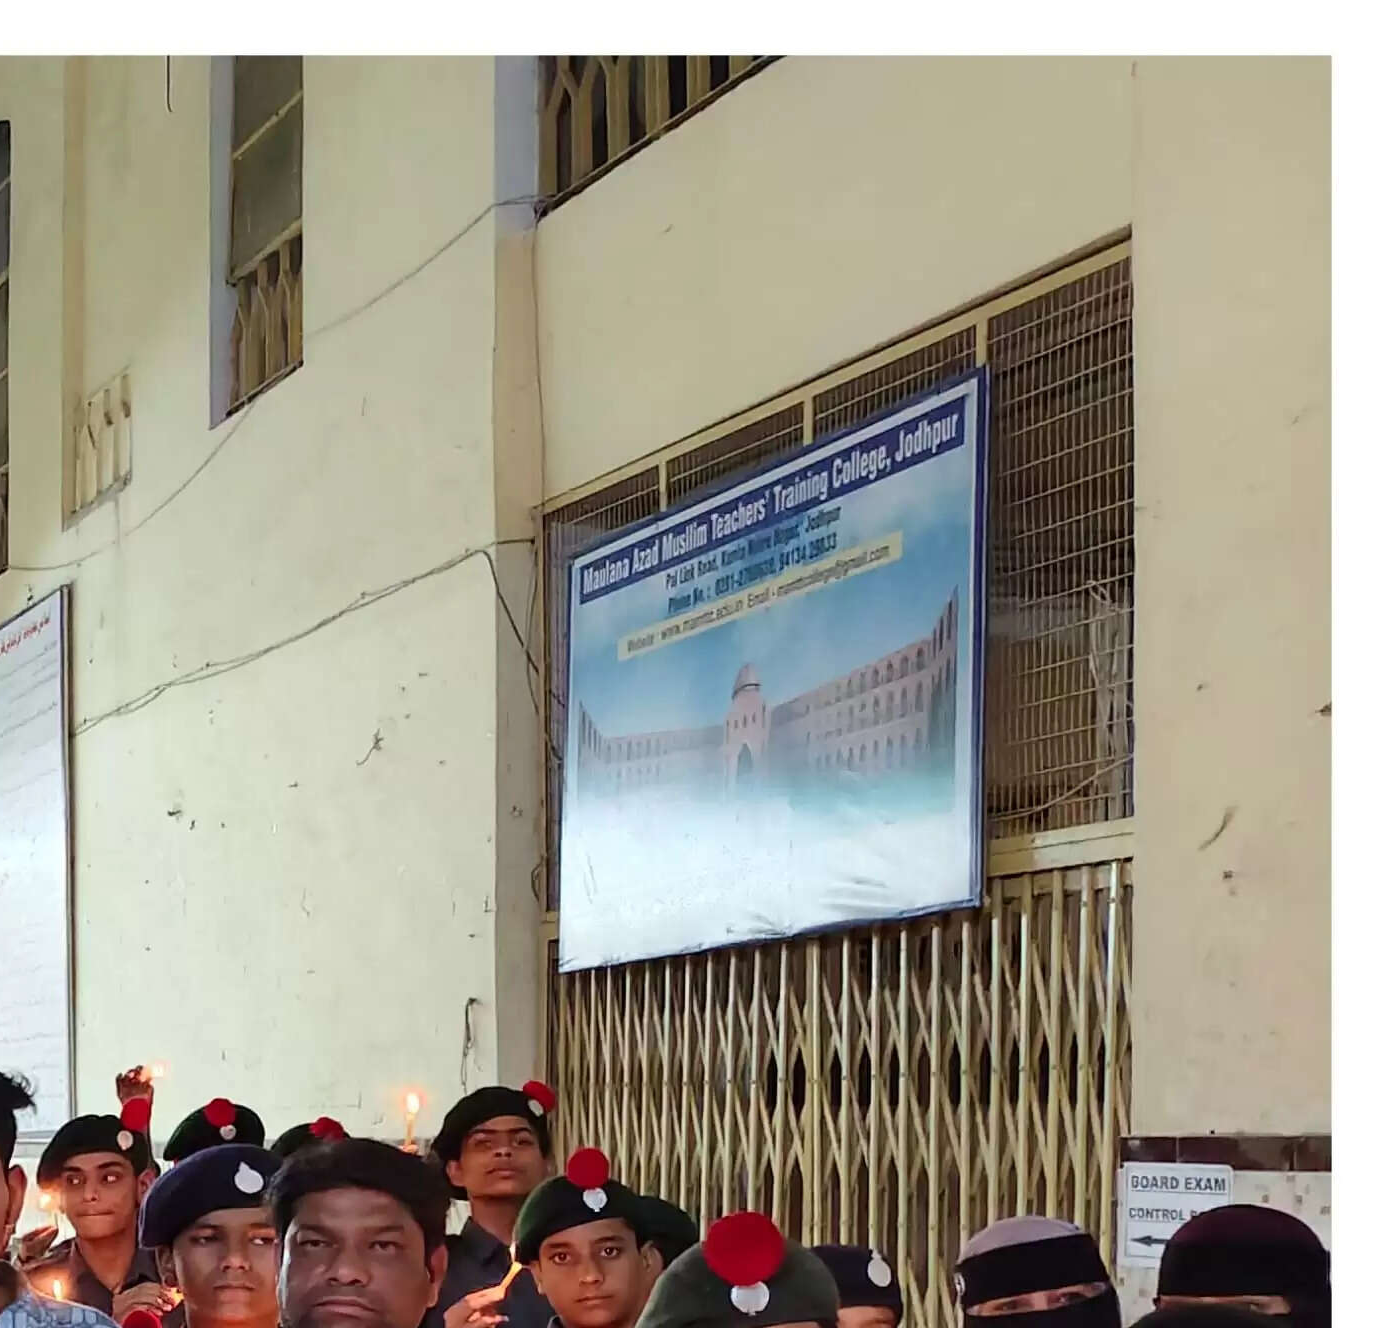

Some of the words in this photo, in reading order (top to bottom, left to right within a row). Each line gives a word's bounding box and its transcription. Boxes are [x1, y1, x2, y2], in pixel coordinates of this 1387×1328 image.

[582, 556, 630, 596] Maulana
[632, 538, 659, 574] Azad
[773, 469, 828, 515] Training
[832, 445, 893, 490] College,
[894, 413, 959, 463] Jodhpur
[1131, 1175, 1180, 1190] BOARD
[1184, 1177, 1226, 1192] EXAM
[1129, 1207, 1187, 1221] CONTROL
